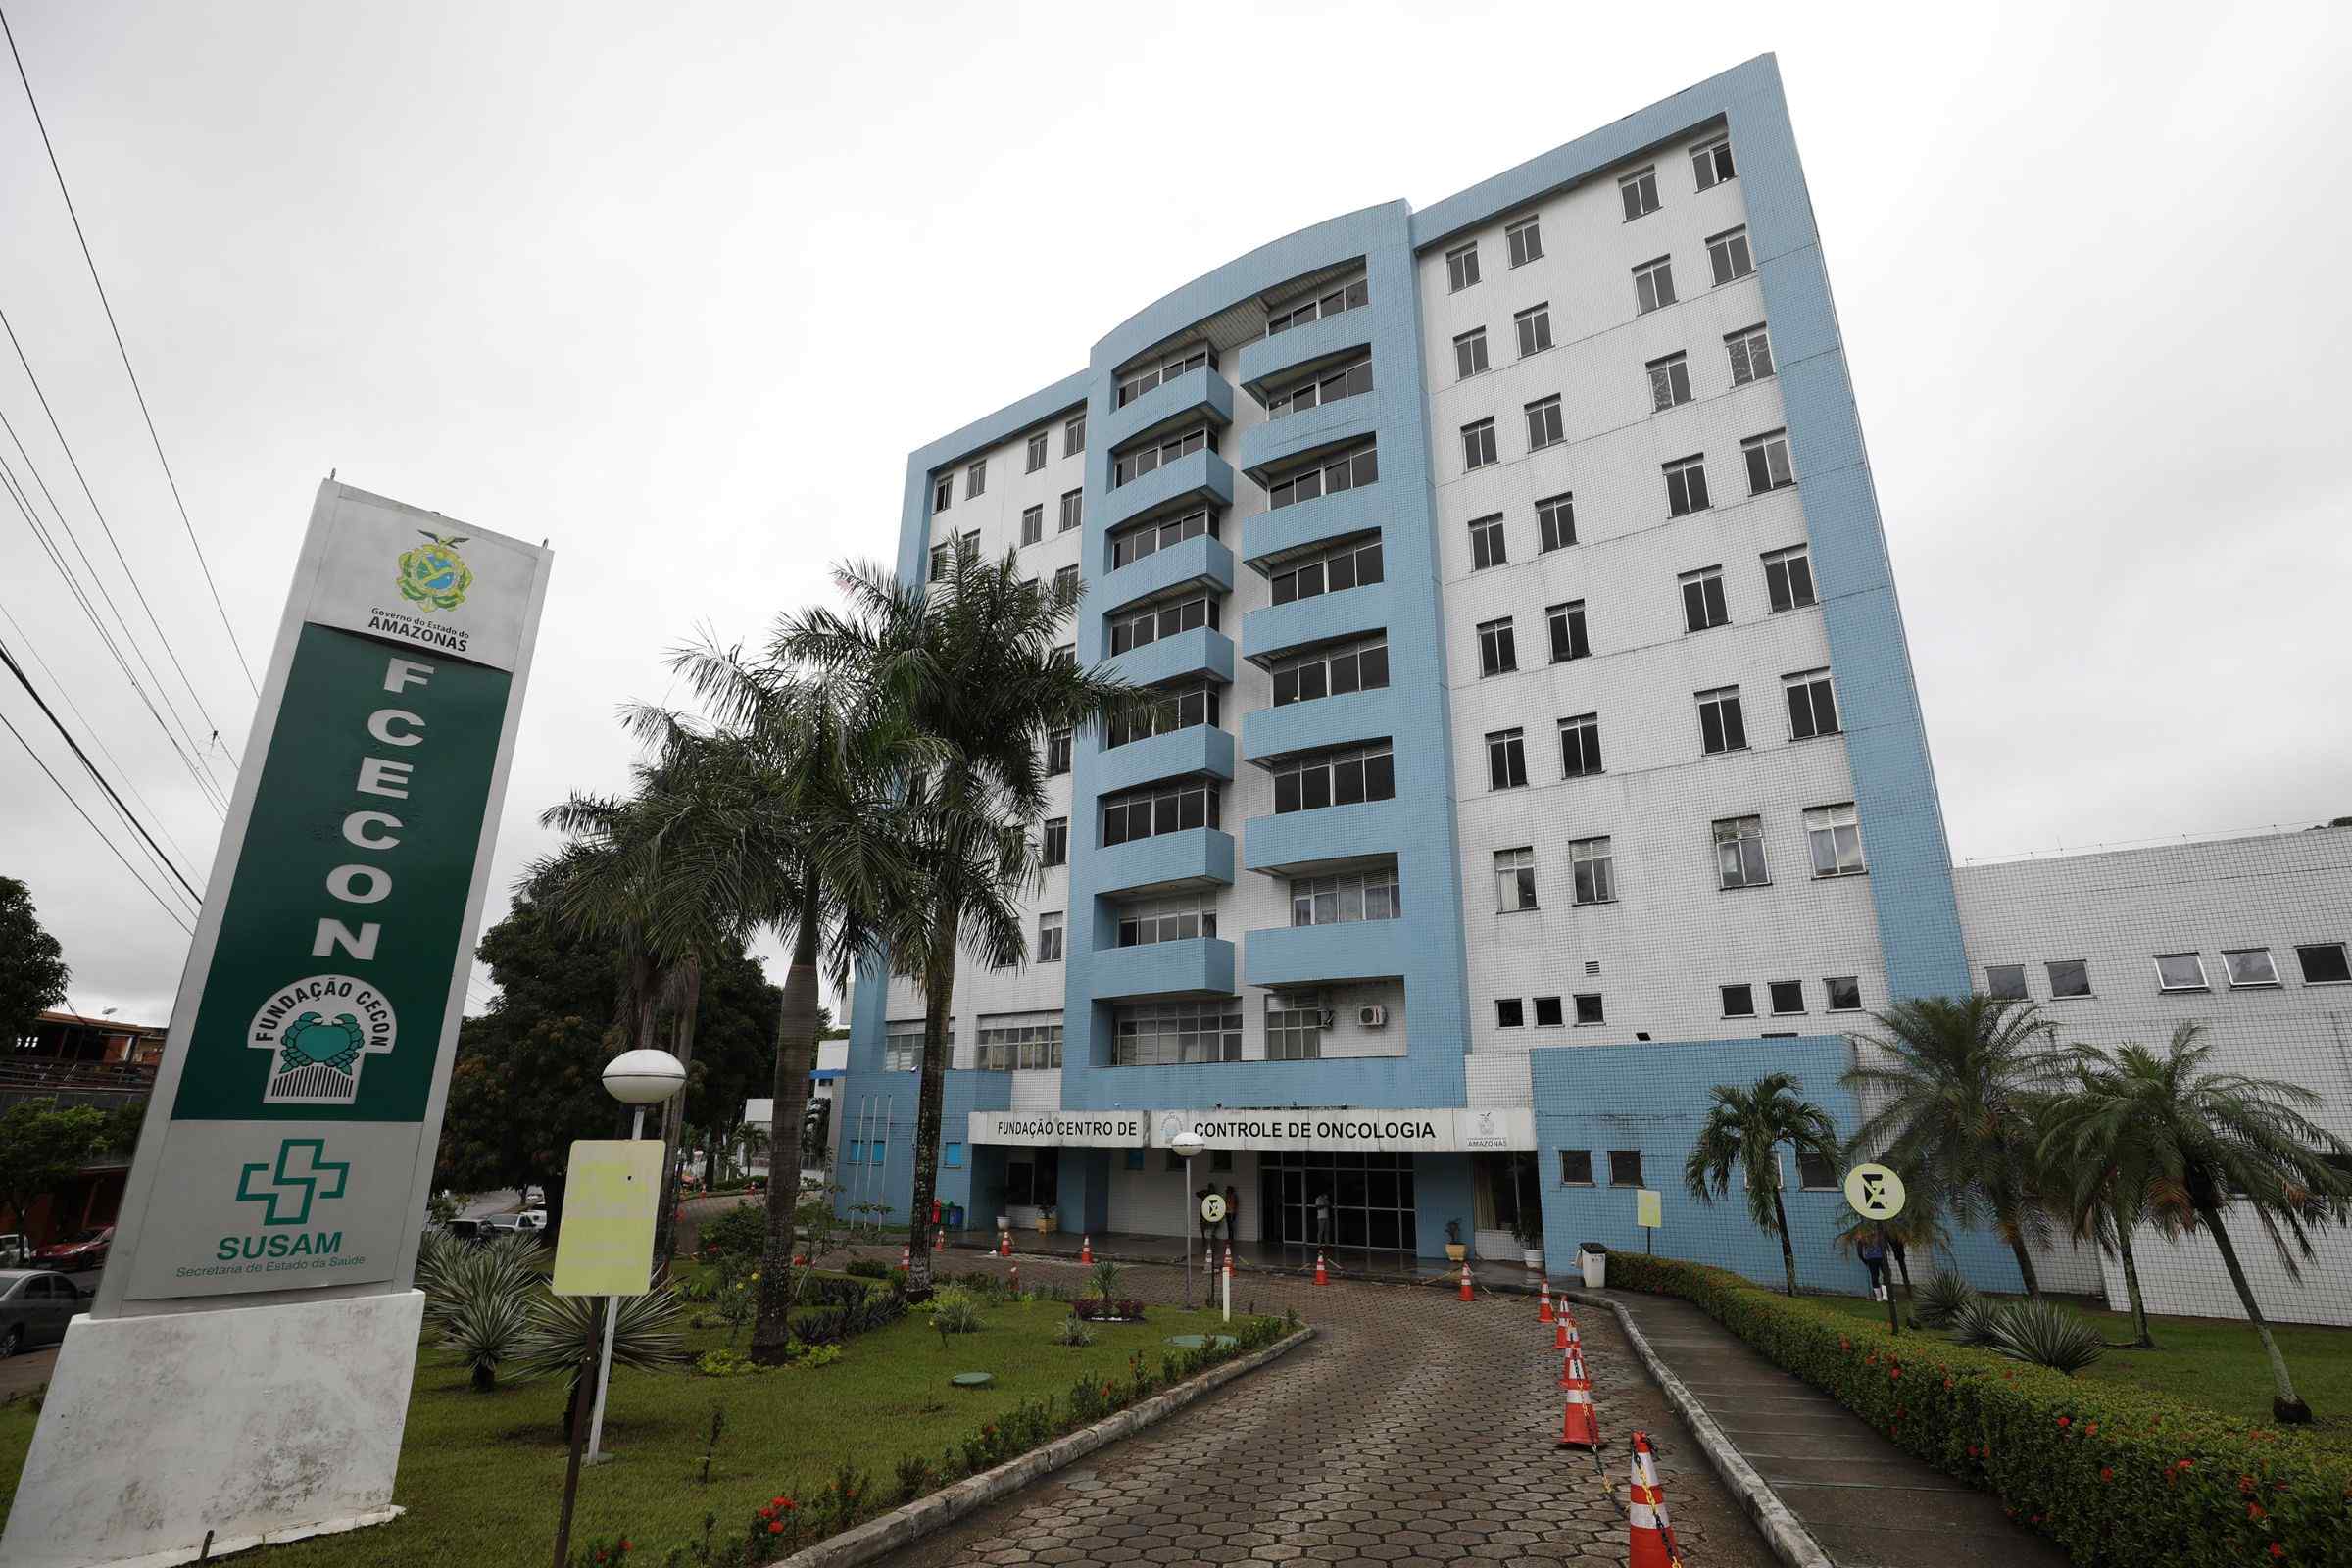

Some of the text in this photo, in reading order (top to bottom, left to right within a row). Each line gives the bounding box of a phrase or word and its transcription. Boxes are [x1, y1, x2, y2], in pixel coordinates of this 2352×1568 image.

[368, 616, 467, 652] AMAZONAS
[371, 607, 469, 639] Governo do Estado do
[312, 657, 435, 961] FCECON
[255, 977, 390, 1047] FUNDAÇÃO CECON
[997, 1118, 1437, 1139] FUNDAÇÃO CENTRO DE CONTROLE DE ONCOLOGIA
[217, 1232, 342, 1261] SUSAM
[175, 1264, 243, 1278] Secretaria
[266, 1257, 308, 1272] Estado
[312, 1256, 326, 1268] da
[328, 1254, 367, 1267] Saúde
